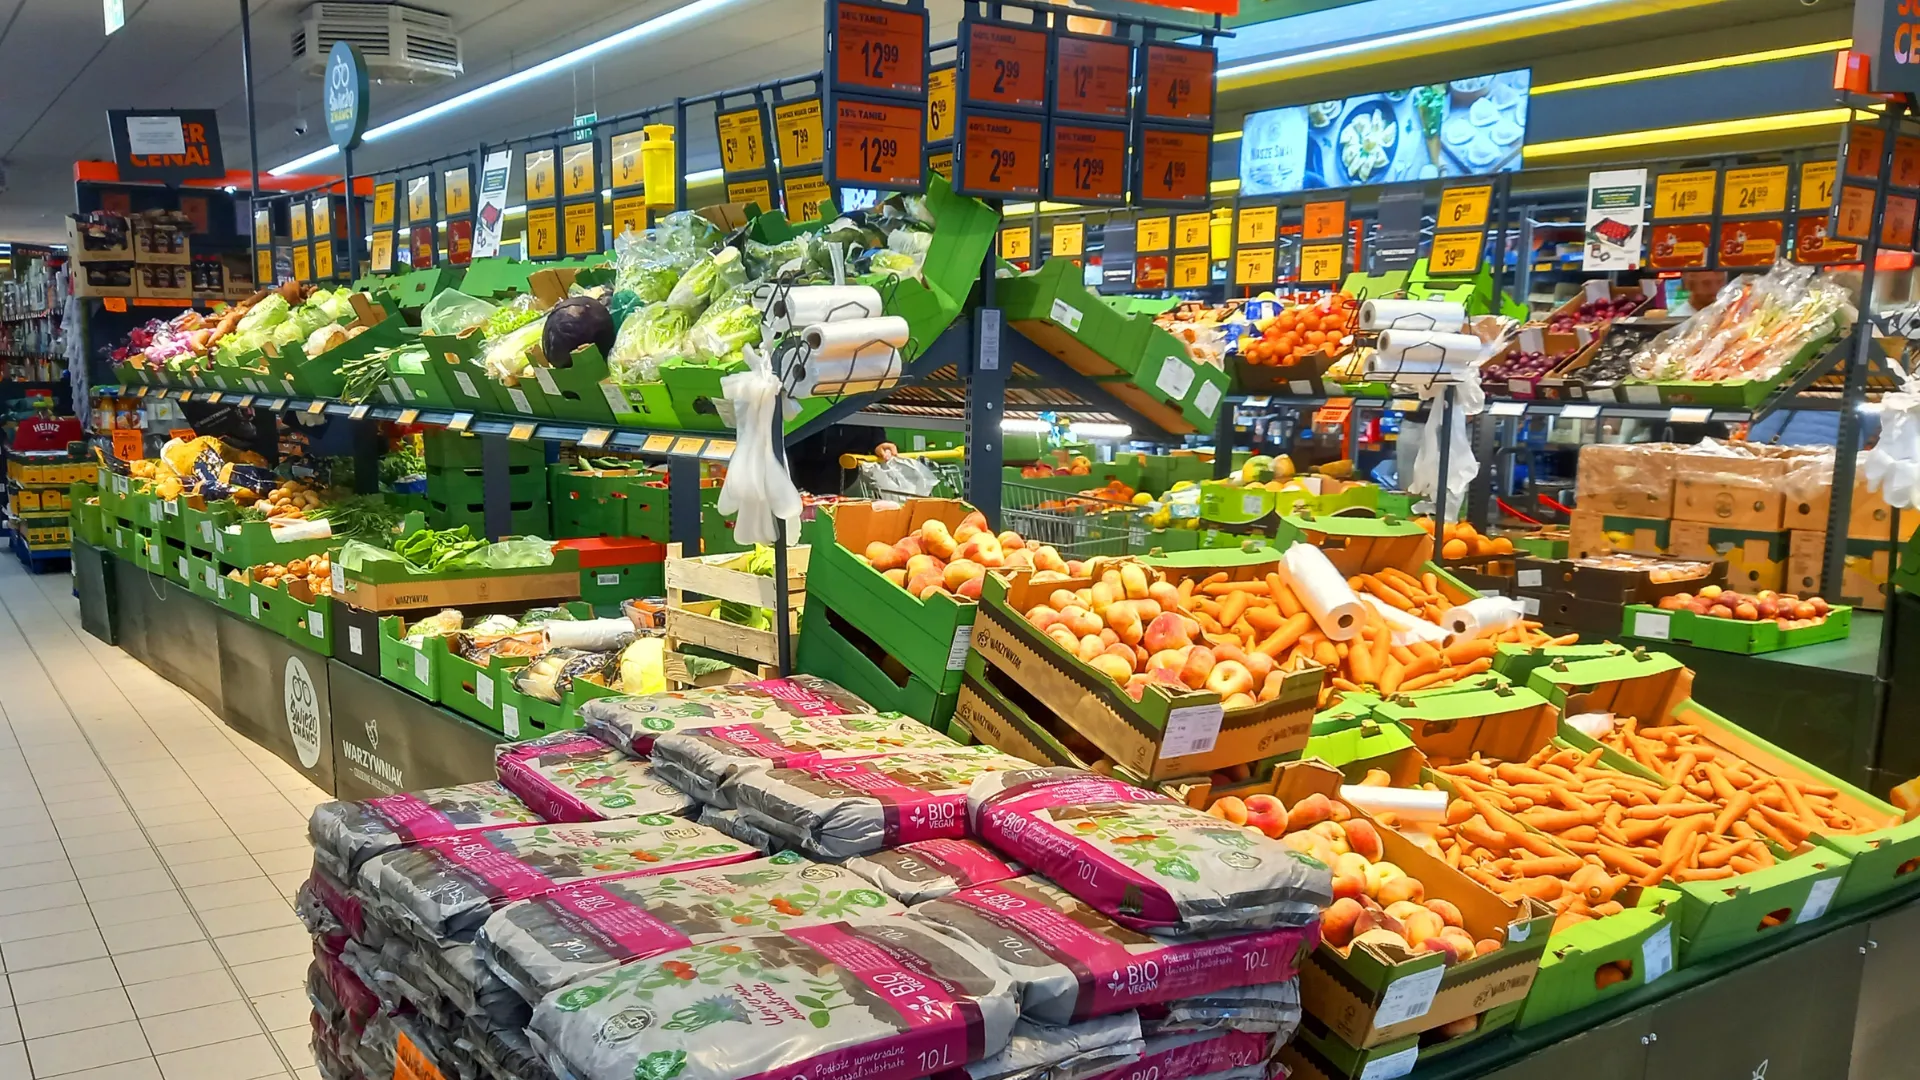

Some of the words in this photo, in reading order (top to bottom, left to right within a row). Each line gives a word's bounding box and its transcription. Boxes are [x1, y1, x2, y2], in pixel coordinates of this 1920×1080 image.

[858, 110, 887, 121] TANIEJ
[33, 422, 60, 433] HEINZ
[990, 637, 1022, 670] WARZYWNIAK
[342, 739, 404, 789] WARZYWNIAK
[928, 802, 955, 821] BIO
[928, 819, 955, 829] VEGAN
[1004, 811, 1028, 833] BIO
[585, 894, 616, 910] BIO
[988, 891, 1027, 909] BIO
[1127, 960, 1159, 986] BIO
[872, 973, 916, 998] BIO
[1127, 981, 1159, 995] VEGAN
[853, 1045, 905, 1066] uniwersalne
